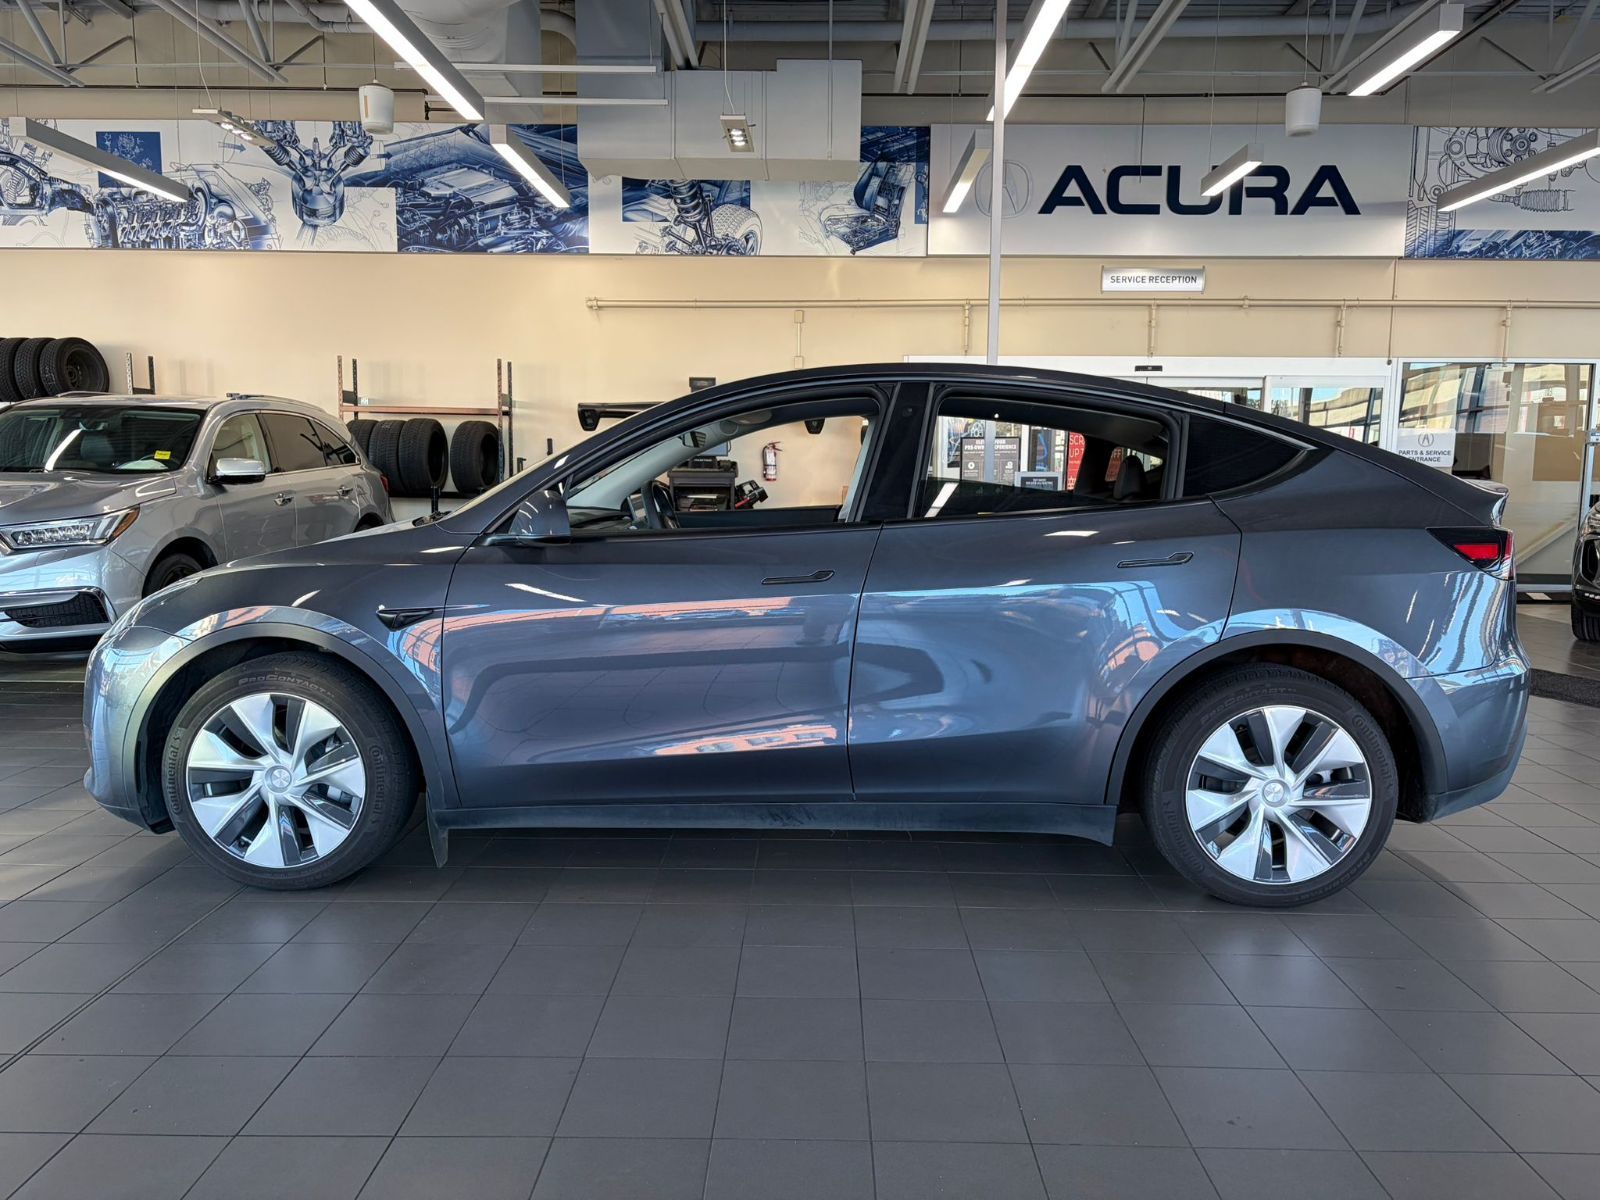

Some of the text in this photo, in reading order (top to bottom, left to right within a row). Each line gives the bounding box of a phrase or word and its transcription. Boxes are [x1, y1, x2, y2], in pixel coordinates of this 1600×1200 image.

[1038, 164, 1361, 216] ACURA
[1110, 275, 1198, 284] SERVICE RECEPTION
[1069, 434, 1085, 445] SCR
[167, 743, 180, 815] Continental
[368, 745, 385, 815] Continental
